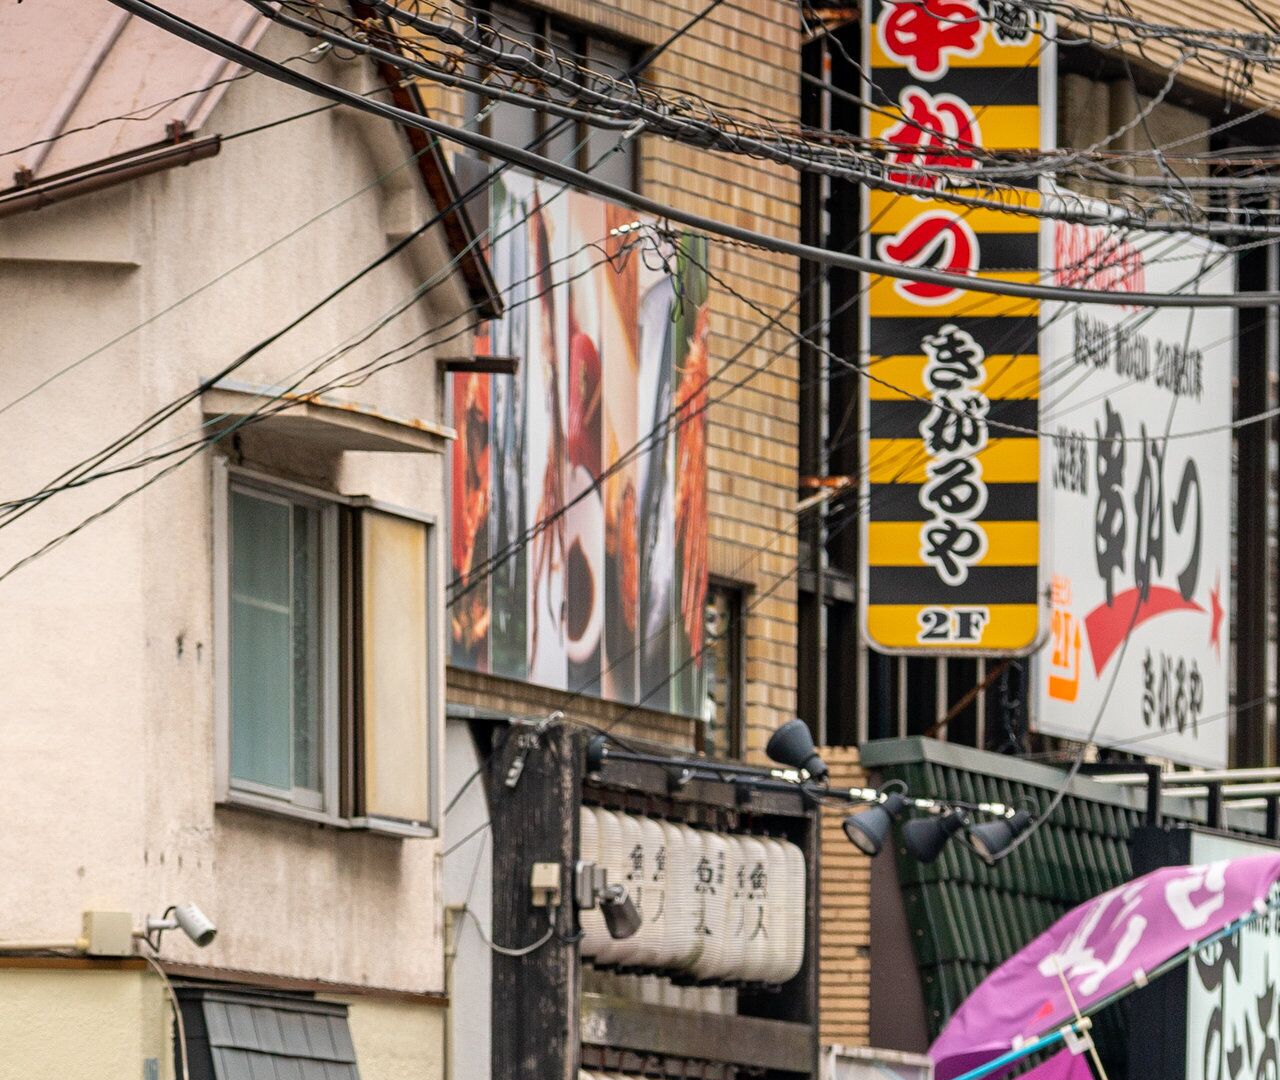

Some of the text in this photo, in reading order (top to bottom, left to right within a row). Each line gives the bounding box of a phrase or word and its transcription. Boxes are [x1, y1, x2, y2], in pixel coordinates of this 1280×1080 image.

[920, 324, 990, 587] きがるや
[918, 611, 989, 643] 2F
